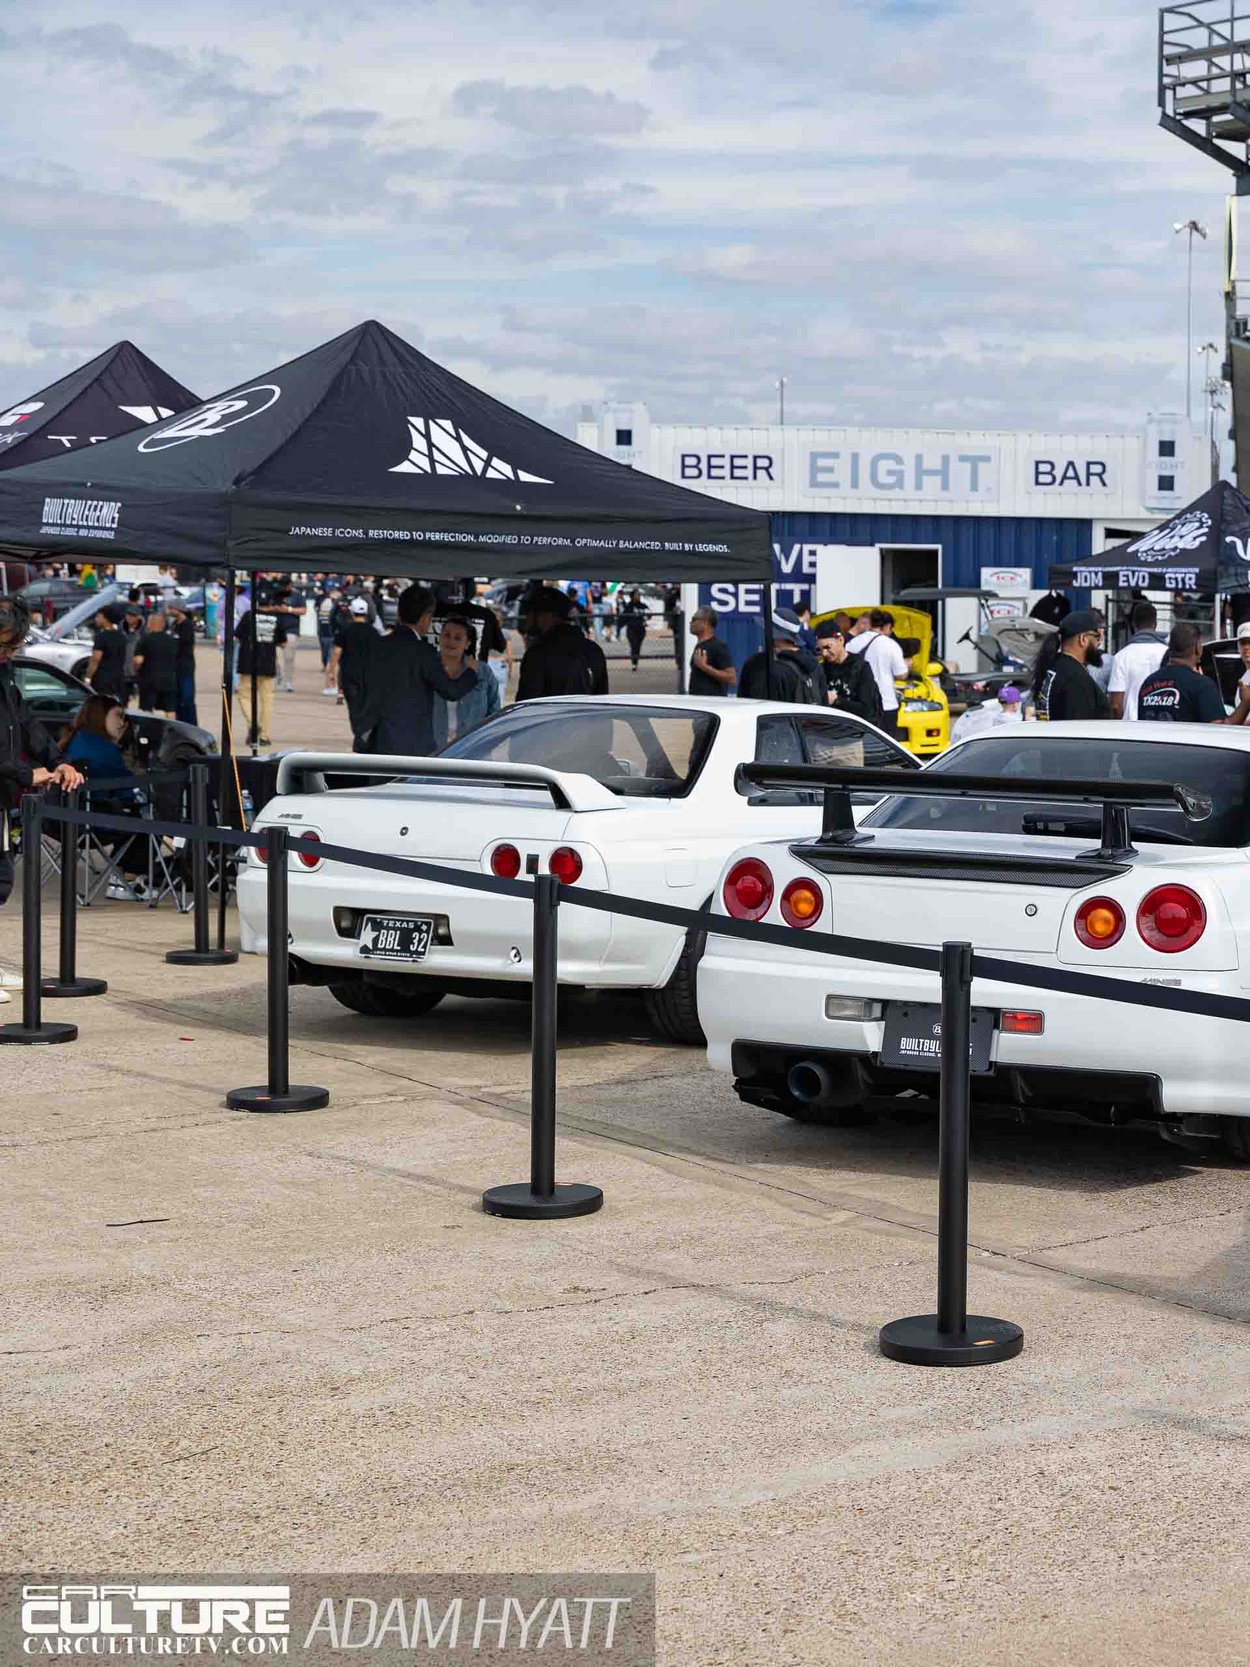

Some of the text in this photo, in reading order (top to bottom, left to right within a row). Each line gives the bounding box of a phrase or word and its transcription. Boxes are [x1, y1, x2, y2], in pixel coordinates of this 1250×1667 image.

[680, 453, 775, 481] BEER
[808, 451, 993, 492] EIGHT
[1033, 459, 1108, 487] BAR
[289, 526, 333, 537] JAPANESE
[368, 529, 411, 540] RESTORED
[412, 531, 424, 540] TO
[478, 534, 518, 544] MODIFIED
[520, 535, 531, 544] TO
[575, 538, 617, 548] OPTIMALLY
[664, 542, 683, 550] BUILT
[684, 543, 694, 551] BY
[1073, 571, 1197, 589] JDM EVO GTR
[382, 920, 415, 929] TEXAS
[377, 929, 428, 952] BBL 32
